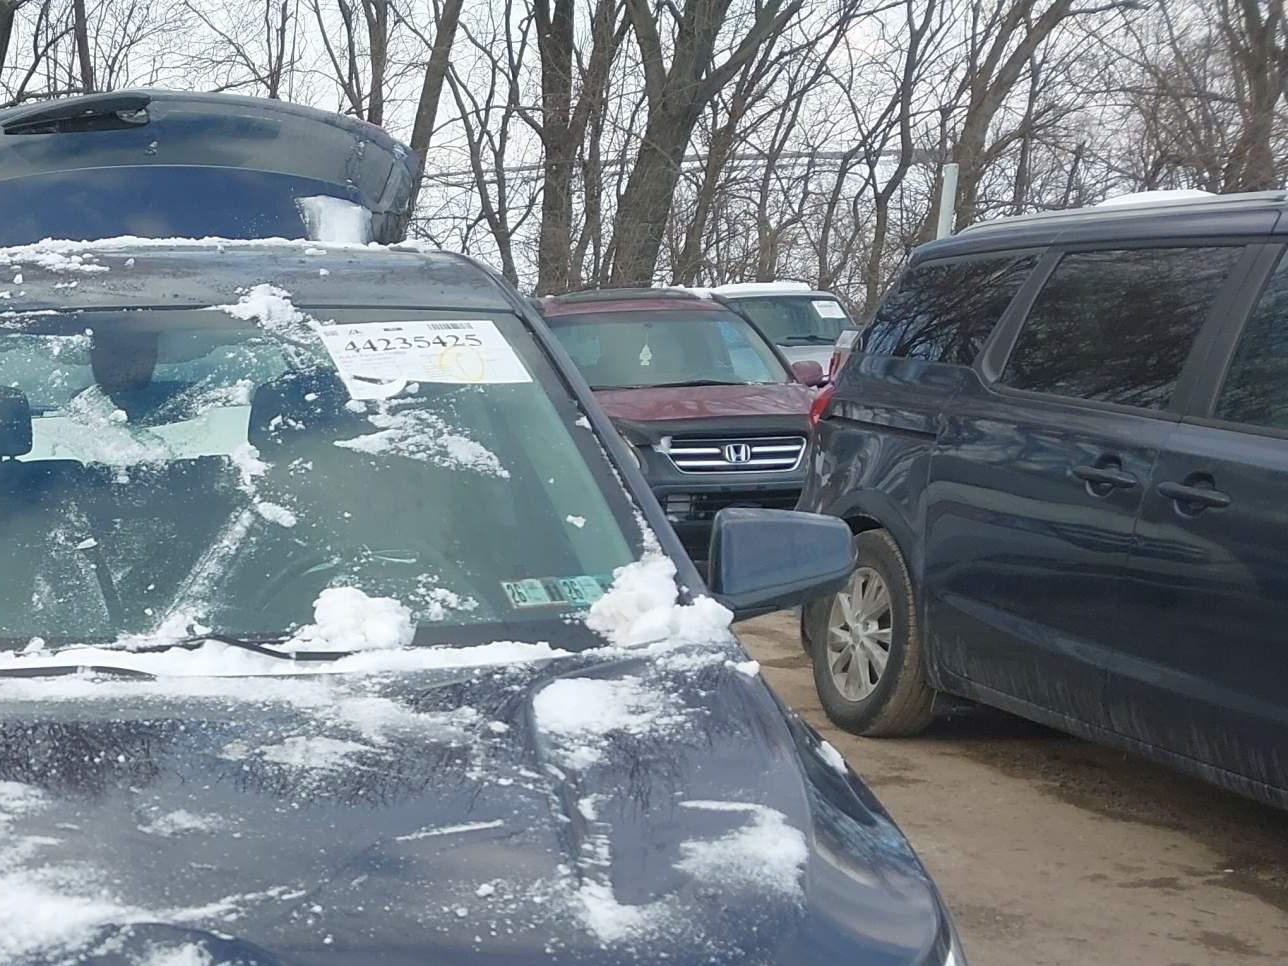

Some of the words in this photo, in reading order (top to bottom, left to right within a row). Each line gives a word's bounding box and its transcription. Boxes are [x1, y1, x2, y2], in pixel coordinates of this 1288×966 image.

[344, 334, 483, 353] 44235425
[506, 583, 528, 603] 26
[562, 580, 585, 600] 26
